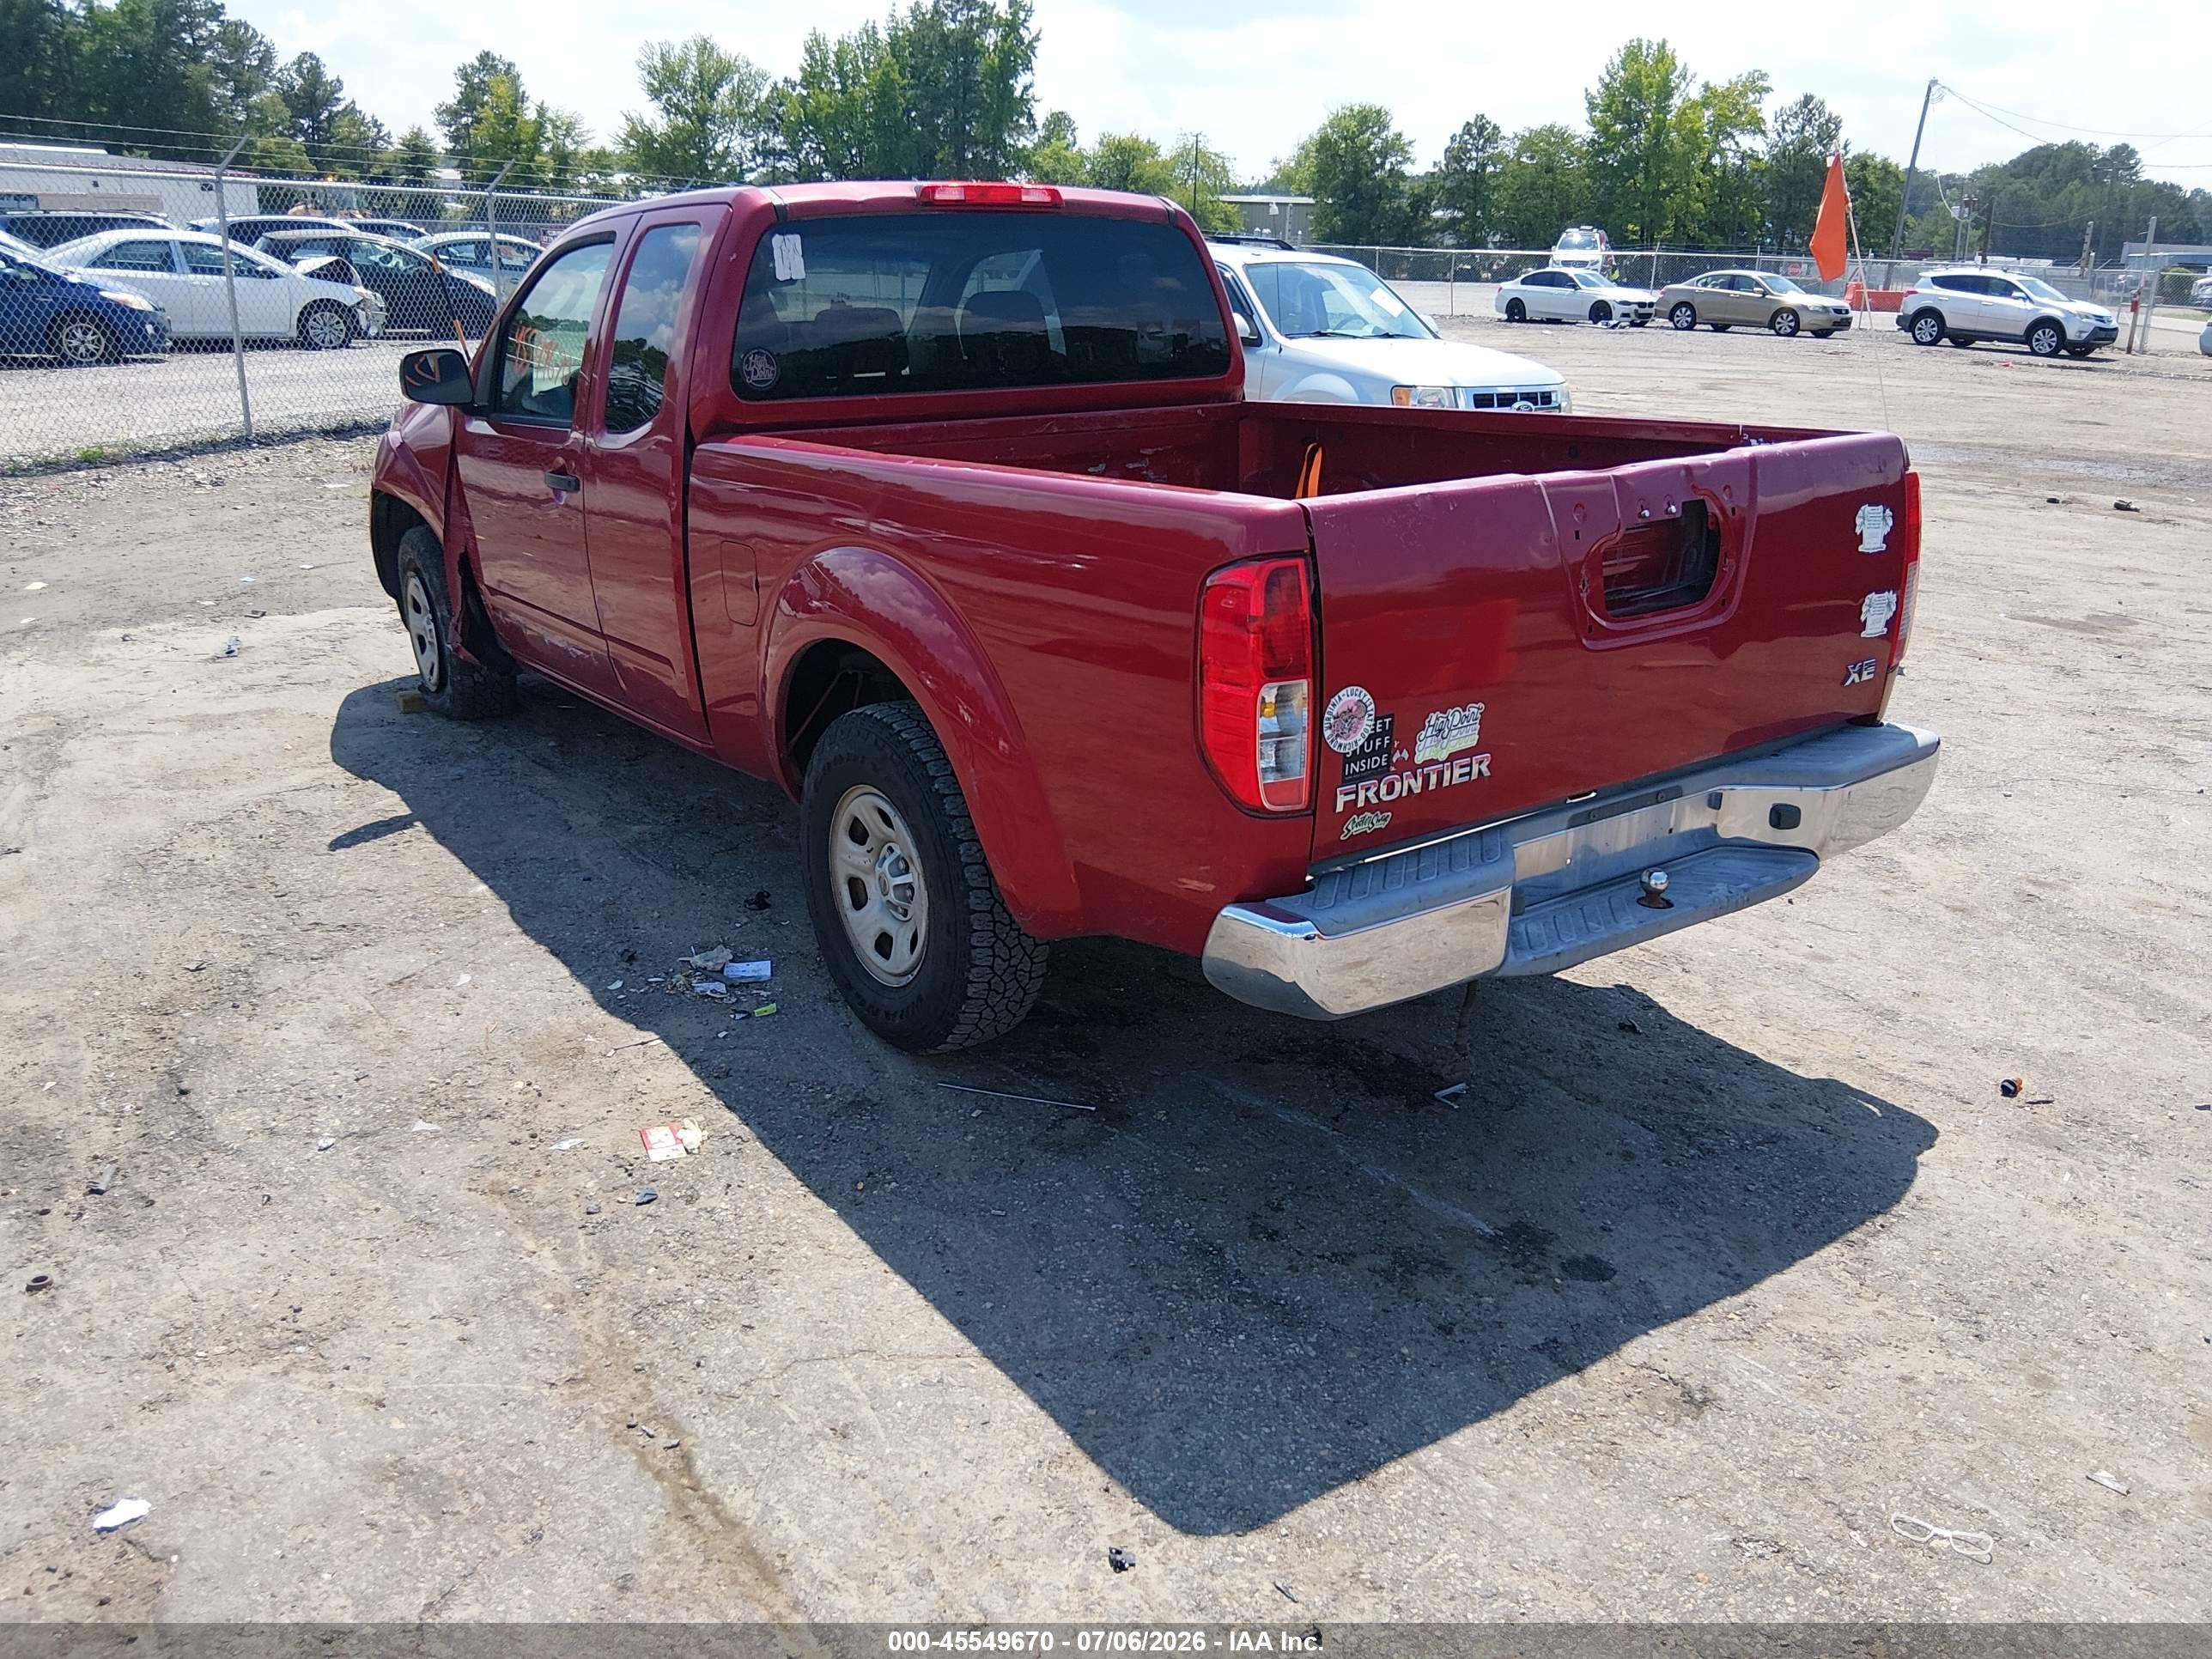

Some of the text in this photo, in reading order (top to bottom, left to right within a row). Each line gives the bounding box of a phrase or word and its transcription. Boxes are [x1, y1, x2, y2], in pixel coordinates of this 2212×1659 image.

[1844, 659, 1876, 687] XE
[1345, 754, 1389, 775] INSIDE
[1335, 753, 1492, 813] FRONTIER
